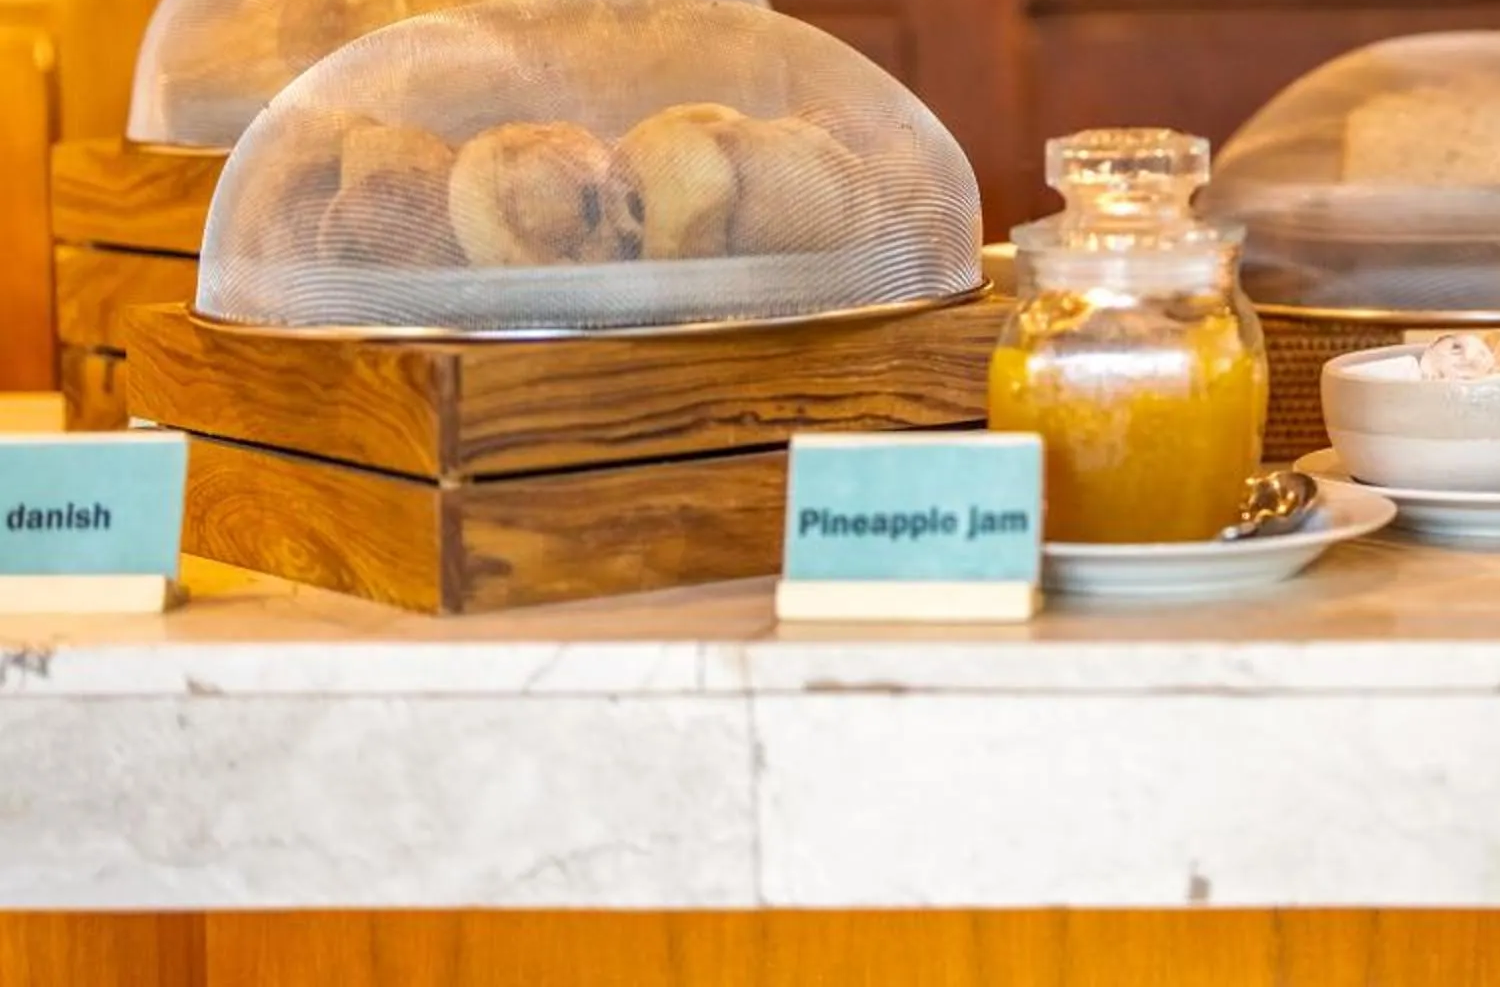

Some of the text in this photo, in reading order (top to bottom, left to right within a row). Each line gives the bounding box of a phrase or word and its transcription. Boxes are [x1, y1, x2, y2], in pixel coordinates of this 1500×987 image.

[7, 502, 111, 530] danish
[799, 506, 1028, 541] Pineapple jam
